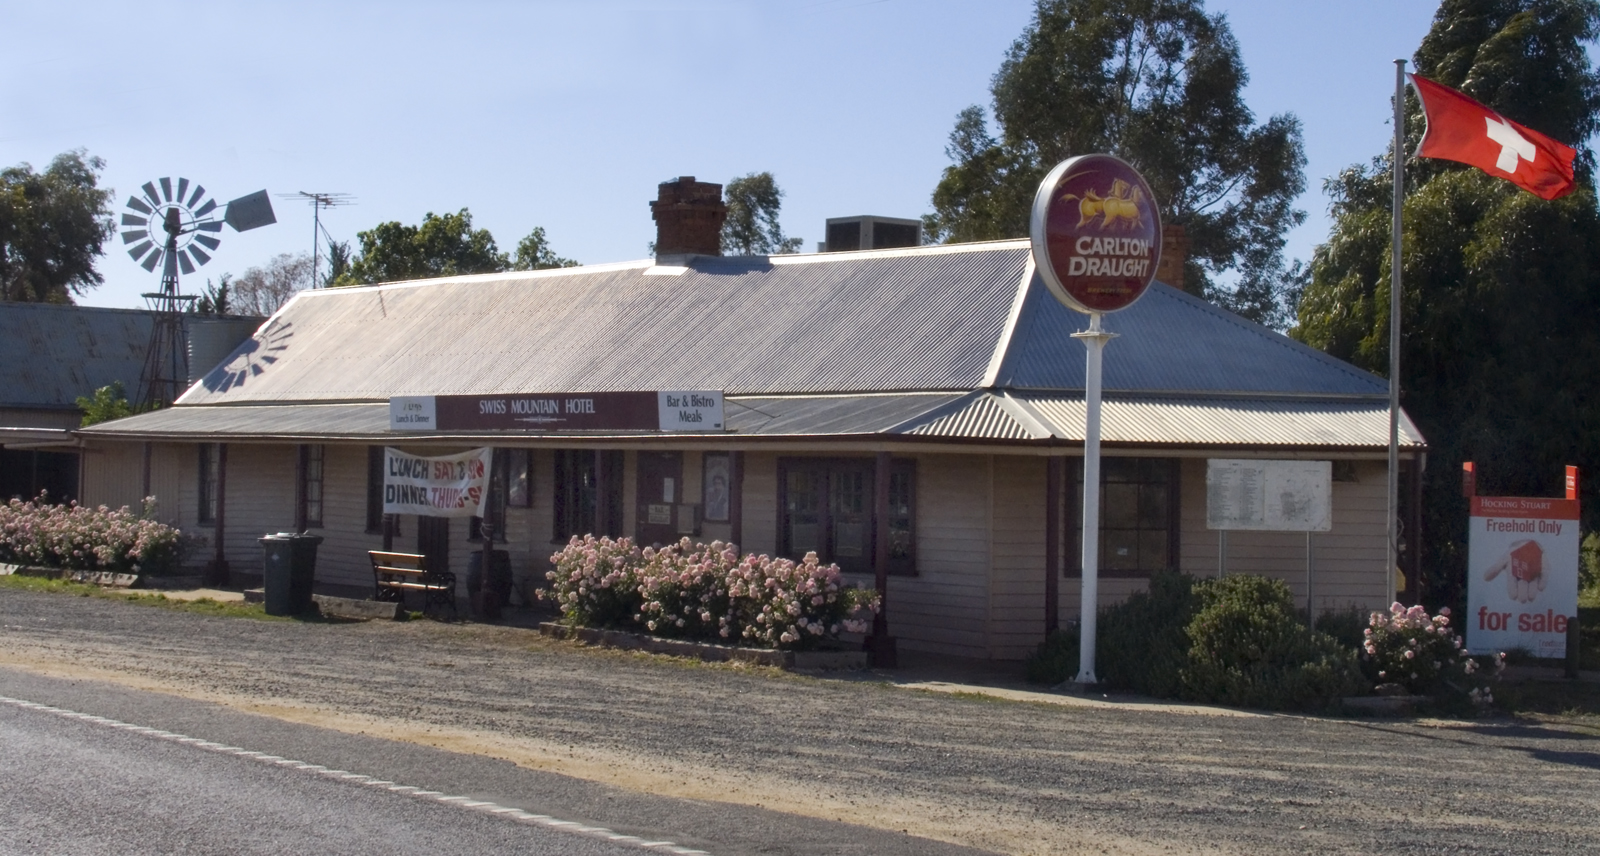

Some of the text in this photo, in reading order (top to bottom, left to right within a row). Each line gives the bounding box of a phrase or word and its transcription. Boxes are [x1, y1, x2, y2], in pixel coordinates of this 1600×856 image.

[1075, 236, 1148, 257] CARLTON
[1067, 256, 1150, 277] DRAUGHT
[479, 398, 596, 414] SWISS MOUNTAIN HOTEL
[667, 394, 715, 408] Bar & Bistro
[395, 413, 409, 423] Lunch
[414, 414, 430, 423] Dinner
[678, 409, 703, 423] Meals
[389, 456, 430, 480] LUNCH
[385, 484, 431, 506] DINNER
[1481, 498, 1552, 510] HOCKING STUART
[1486, 518, 1562, 537] Freehold Only
[1478, 605, 1567, 634] for sale
